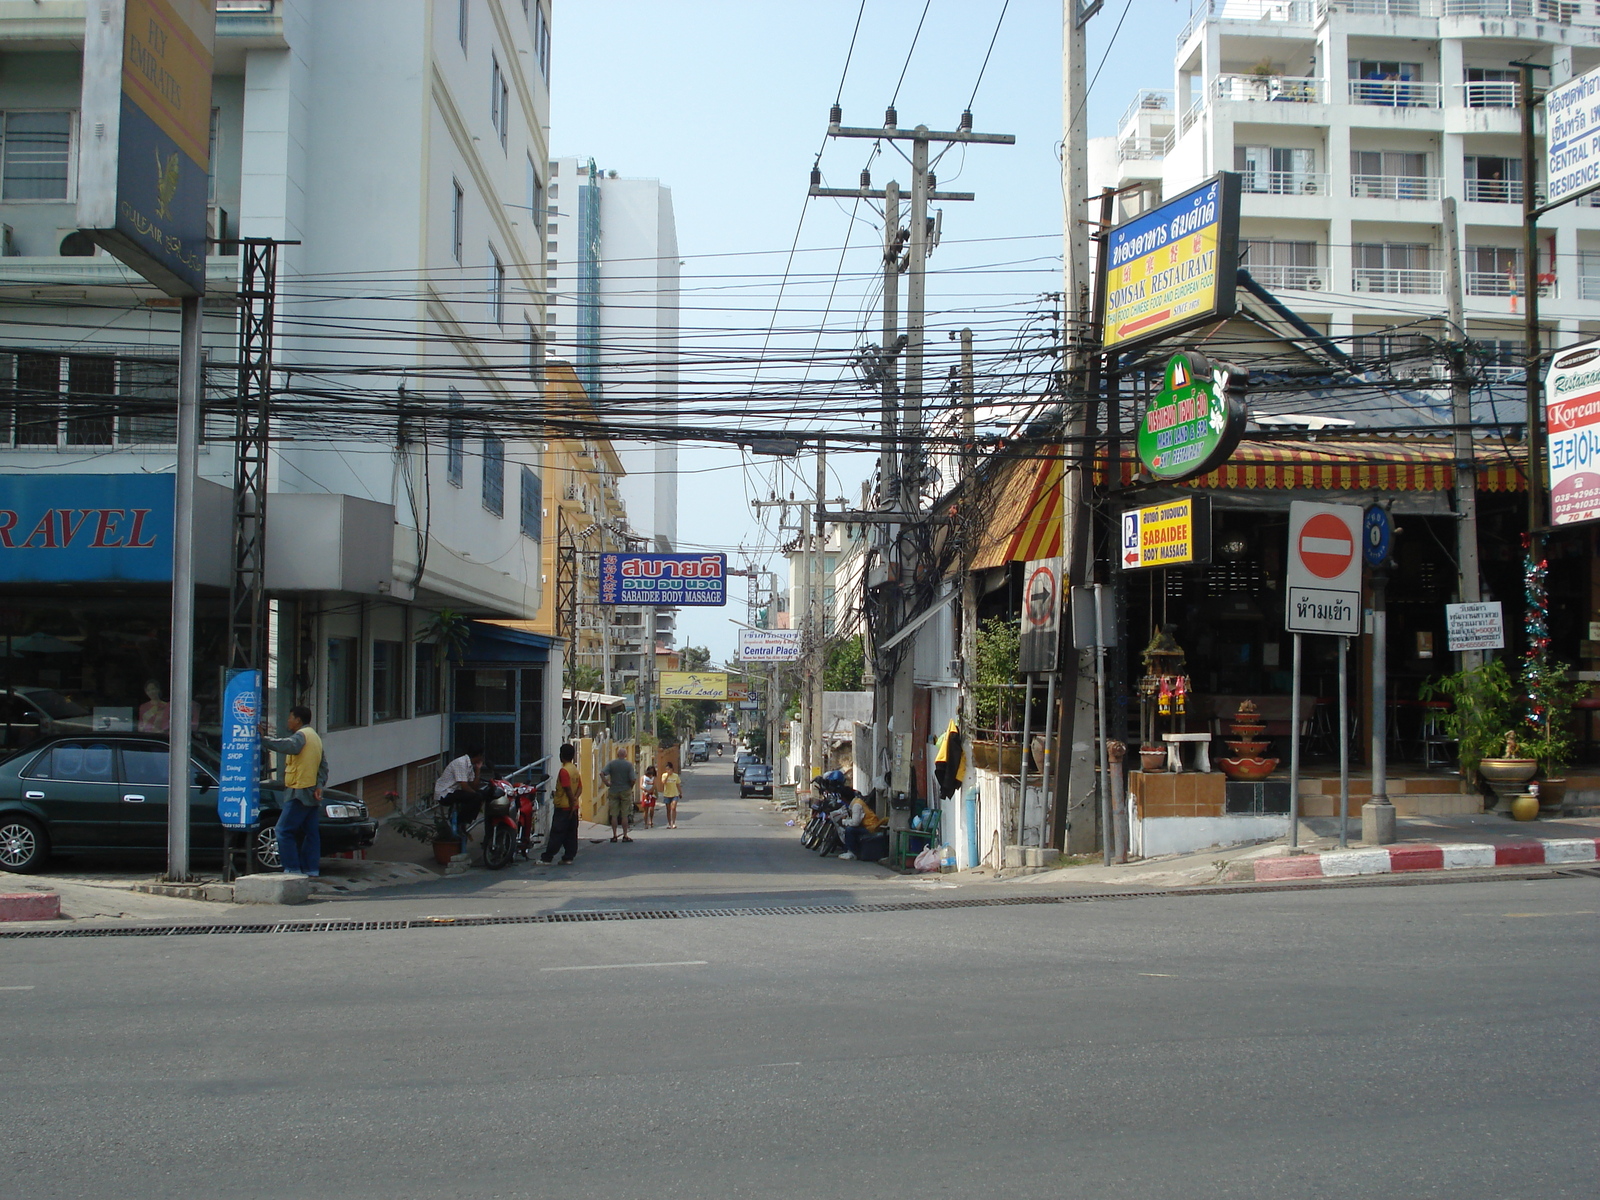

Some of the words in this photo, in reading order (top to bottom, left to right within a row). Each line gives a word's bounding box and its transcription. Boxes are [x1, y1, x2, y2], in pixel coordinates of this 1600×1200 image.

[148, 17, 168, 58] FLY
[130, 33, 181, 111] EMIRATES
[1549, 142, 1589, 174] CENTRAL
[1549, 161, 1600, 199] RESIDENCE
[149, 223, 163, 245] AIR
[1113, 223, 1168, 266] ห้องอาหาร
[1171, 181, 1219, 239] สมศักดิ์
[1108, 279, 1147, 311] SOMSAK
[1151, 250, 1215, 295] RESTAURANT
[1117, 308, 1130, 322] FOOD
[1130, 299, 1150, 317] CHINESE
[1150, 295, 1163, 310] FOOD
[1163, 290, 1174, 305] AND
[1174, 281, 1200, 300] EUROPEAN
[1200, 273, 1214, 290] FOOD
[1173, 301, 1189, 316] SINCE
[1549, 400, 1600, 428] Korean
[1157, 429, 1173, 450] MARK
[1174, 424, 1189, 445] LAND
[1189, 423, 1195, 440] &
[1196, 418, 1208, 439] SPA
[1171, 441, 1205, 465] RESTAURANT
[1555, 487, 1600, 503] 038-42963
[1556, 498, 1600, 513] 038-41033
[0, 508, 157, 548] RAVEL
[1568, 513, 1580, 521] 70
[1143, 524, 1187, 546] SABAIDEE
[1143, 547, 1158, 561] BODY
[1160, 543, 1187, 559] MASSAGE
[621, 556, 721, 577] สบายดี
[623, 578, 655, 590] อาบ
[658, 578, 683, 590] อบ
[685, 578, 722, 590] นวด
[621, 590, 660, 602] SABAIDEE
[661, 590, 683, 602] BODY
[685, 591, 722, 602] MASSAGE
[1297, 596, 1351, 621] ห้ามเข้า
[744, 646, 774, 655] Central
[775, 646, 798, 655] Place
[665, 686, 692, 695] Sabai
[695, 688, 723, 698] Lodge
